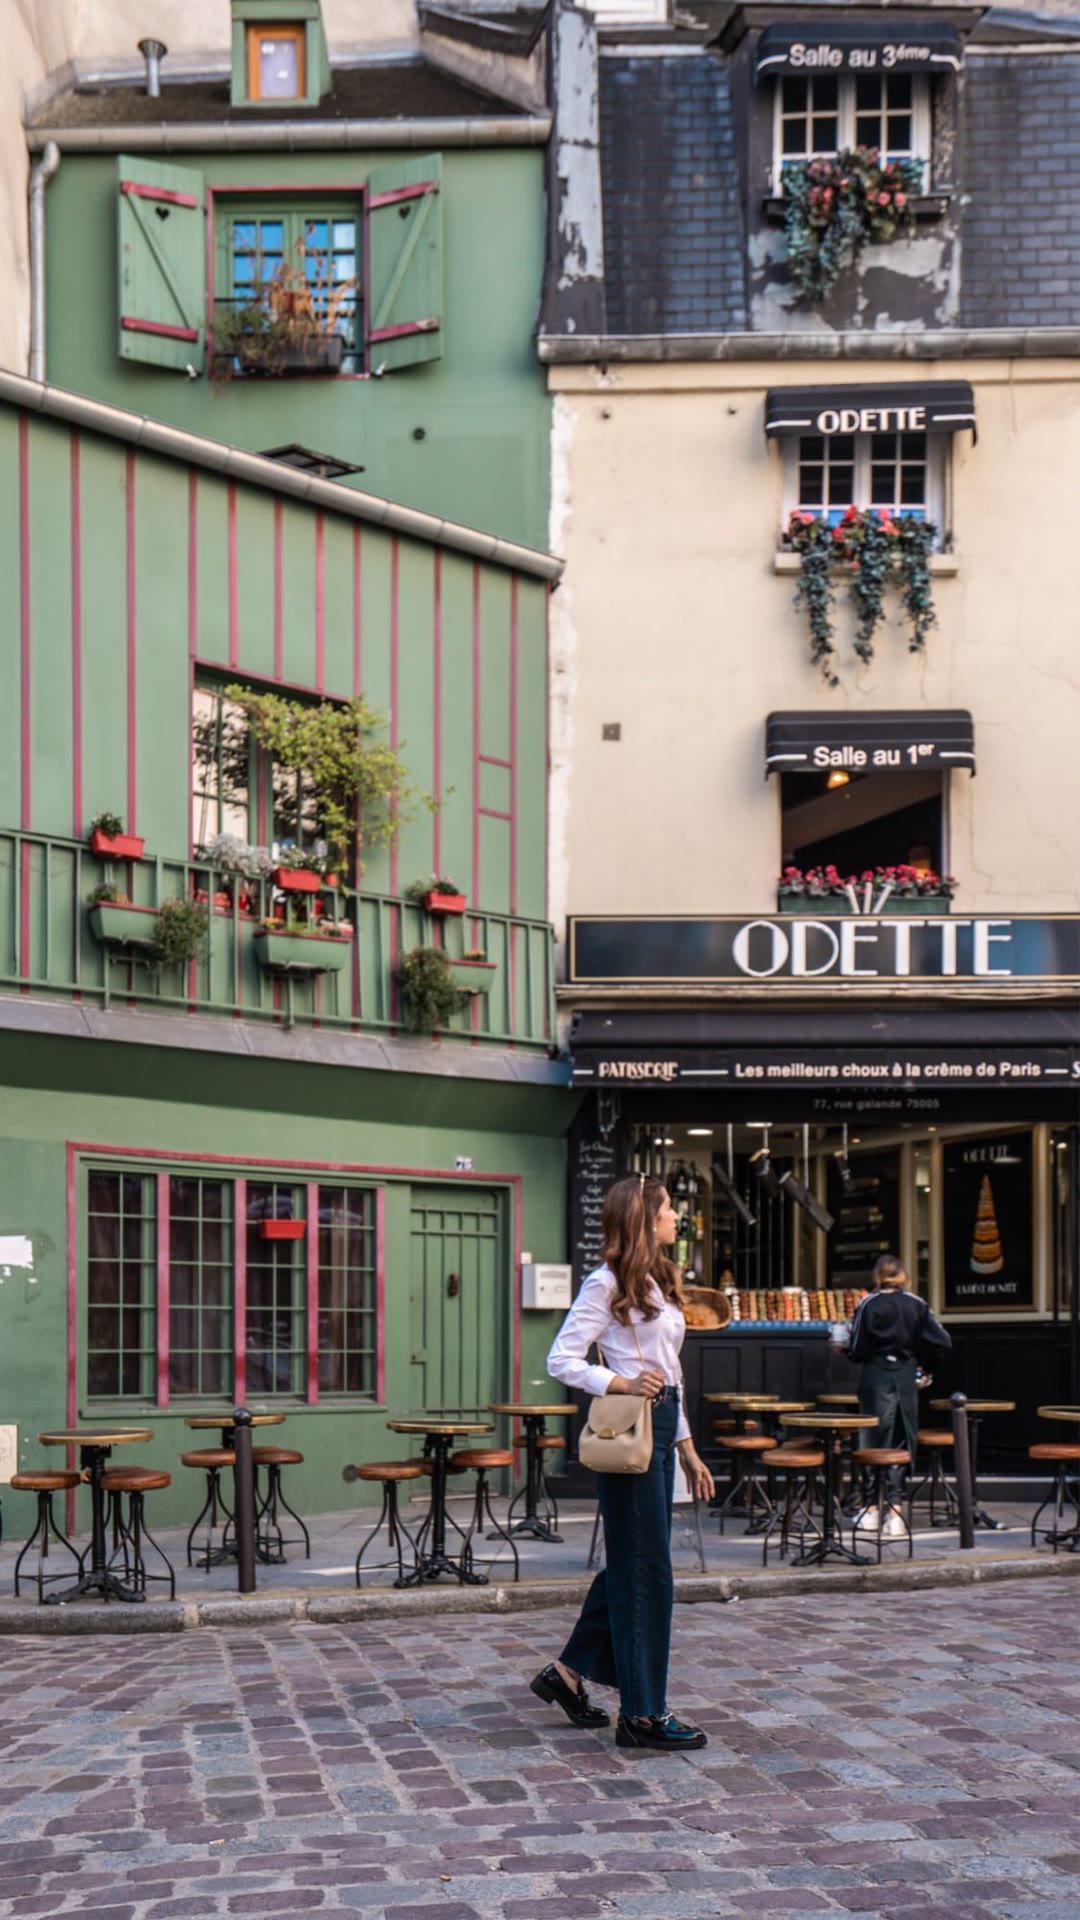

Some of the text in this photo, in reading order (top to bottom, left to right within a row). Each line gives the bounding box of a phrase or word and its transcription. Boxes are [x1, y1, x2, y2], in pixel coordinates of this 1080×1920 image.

[789, 43, 843, 67] Salle
[848, 49, 876, 67] au
[817, 406, 927, 434] ODETTE
[813, 744, 935, 767] Salle au 1er
[732, 919, 1012, 977] ODETTE
[735, 1062, 764, 1078] Les
[767, 1062, 838, 1078] meilleurs
[842, 1062, 888, 1078] choux
[892, 1061, 903, 1078] à
[905, 1062, 920, 1078] la
[976, 1062, 996, 1078] de
[1000, 1062, 1041, 1078] Paris
[856, 1099, 902, 1110] galande
[906, 1099, 940, 1108] 75005
